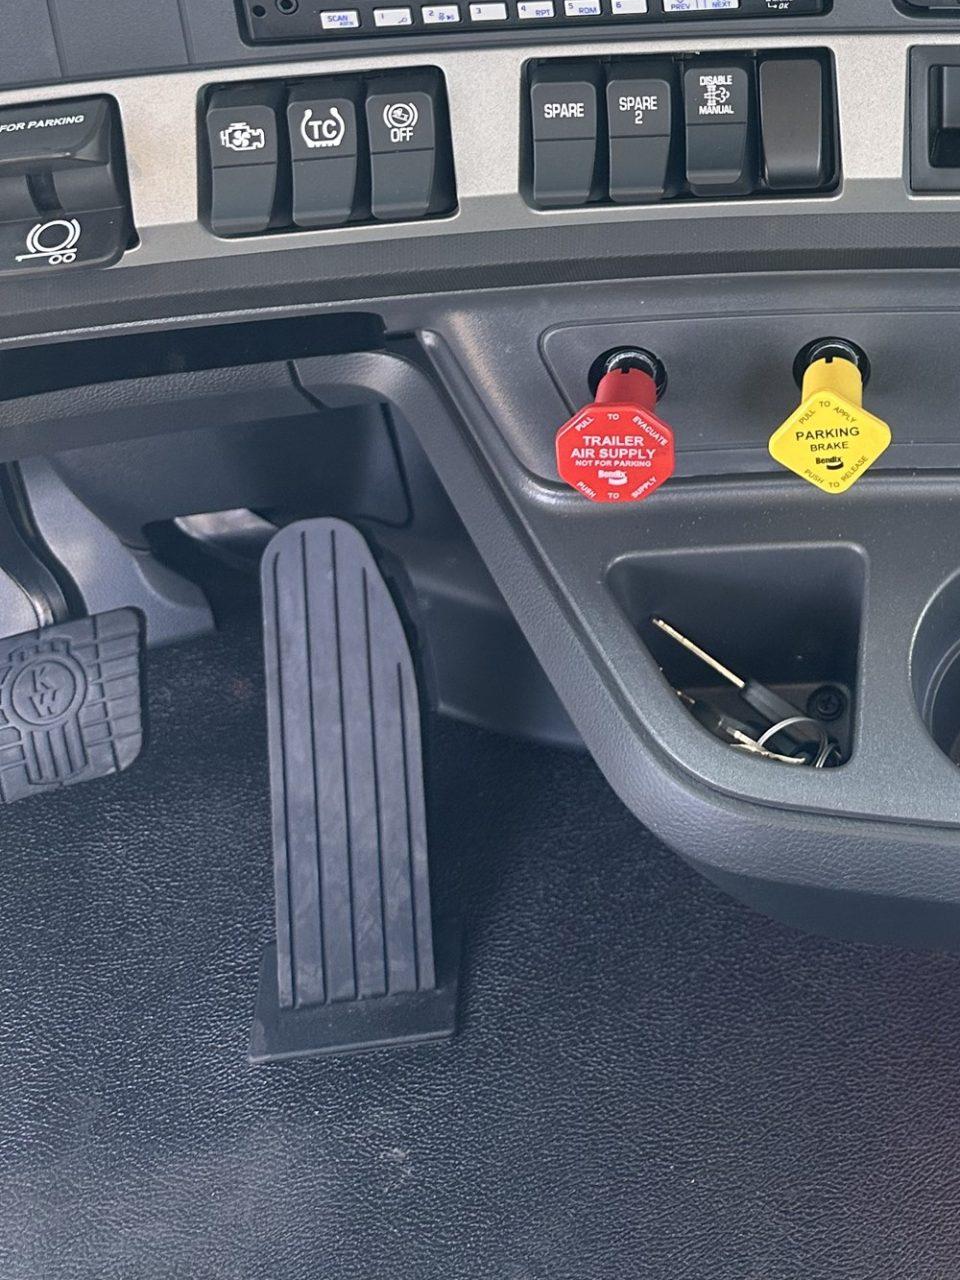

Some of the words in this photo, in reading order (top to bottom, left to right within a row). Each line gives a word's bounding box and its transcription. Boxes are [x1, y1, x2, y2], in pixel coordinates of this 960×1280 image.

[712, 0, 731, 8] NEXT
[778, 2, 790, 10] OK
[328, 15, 348, 23] SCAN
[699, 74, 732, 86] DISABLE
[544, 103, 584, 118] SPARE
[619, 96, 658, 111] SPARE
[698, 104, 734, 115] MANUAL
[0, 122, 26, 132] FOR
[27, 114, 84, 129] PARKING
[634, 110, 643, 124] 2
[308, 119, 337, 141] TC
[390, 127, 414, 143] OFF
[798, 408, 816, 424] PULL
[819, 400, 830, 408] TO
[833, 406, 856, 423] APPLY
[574, 416, 595, 432] PULL
[632, 415, 668, 446] EVACUATE
[796, 426, 860, 441] PARKING
[582, 436, 644, 446] TRAILER
[810, 441, 850, 452] BRAKE
[570, 448, 595, 458] AIR
[598, 448, 656, 460] SUPPLY
[804, 468, 824, 484] PUSH
[840, 455, 868, 482] RELEASE
[576, 480, 597, 498] PUSH
[630, 476, 657, 498] SUPPLY
